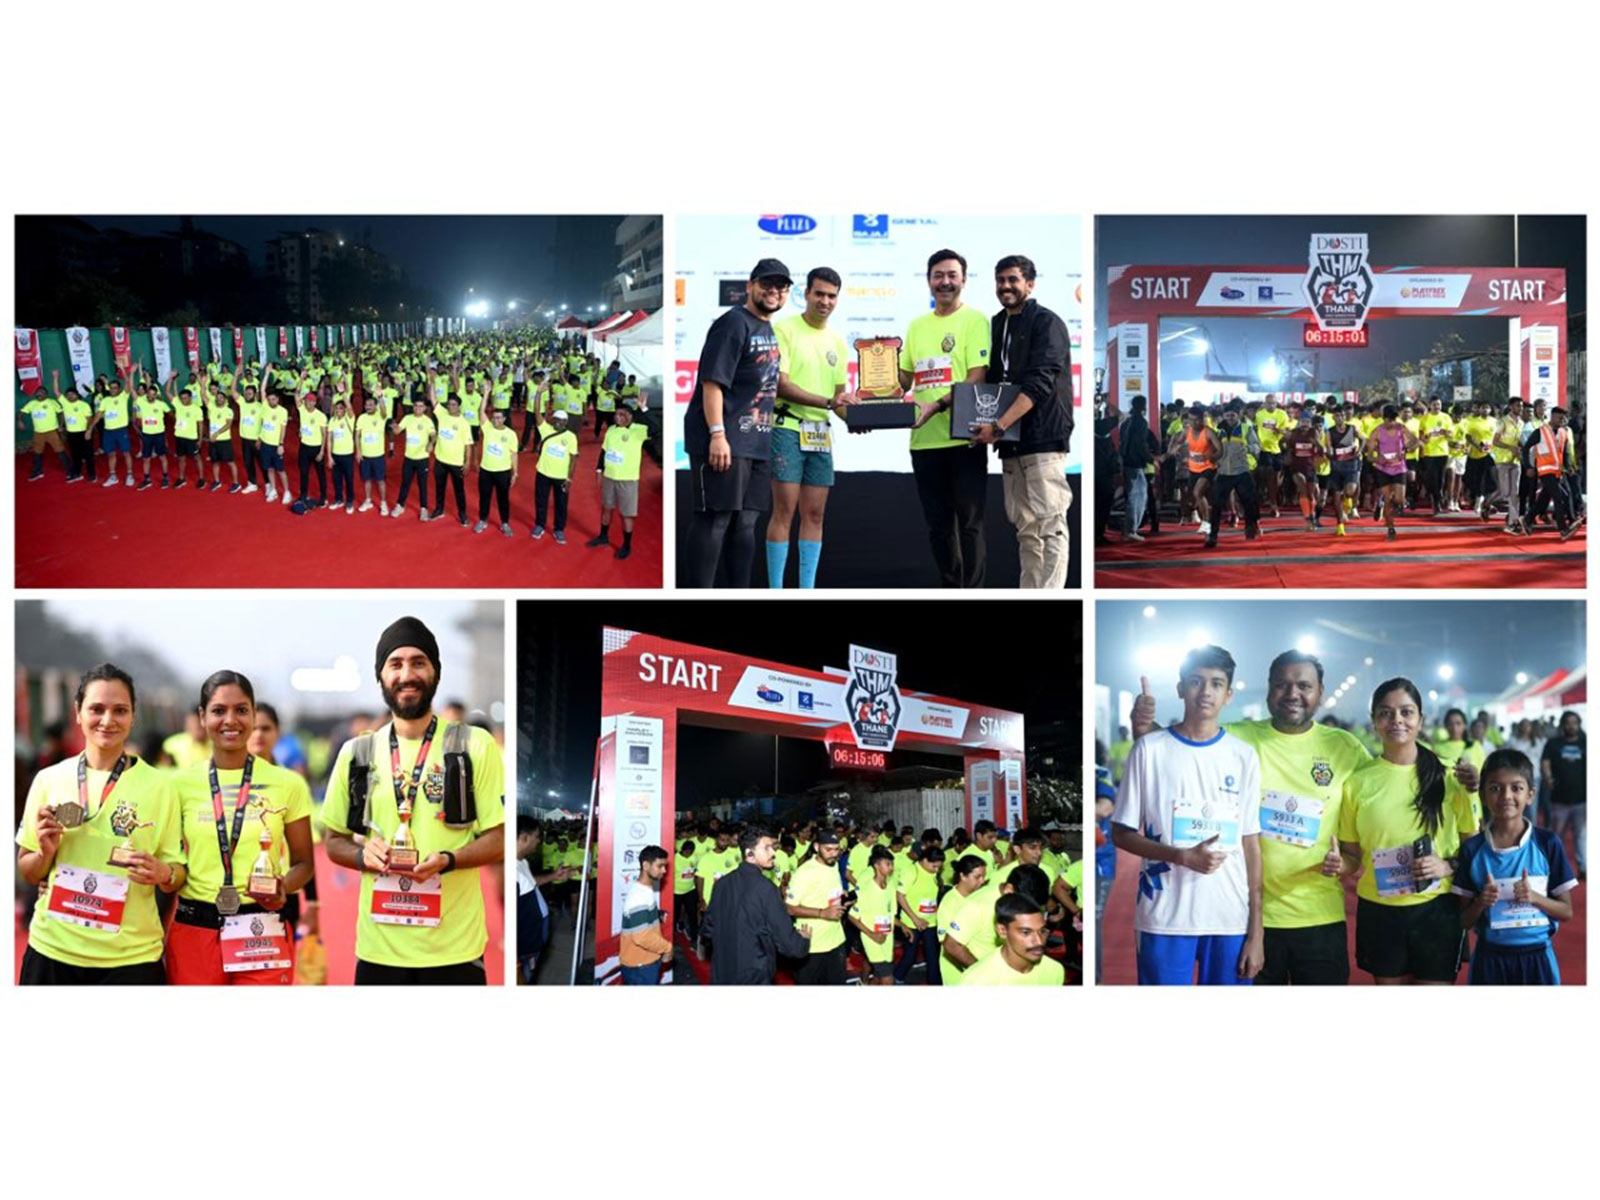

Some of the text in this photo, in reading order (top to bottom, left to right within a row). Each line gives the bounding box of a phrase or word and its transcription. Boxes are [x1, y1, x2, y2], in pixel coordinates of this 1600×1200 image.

[1317, 236, 1362, 250] DOSTI
[1320, 254, 1360, 277] THM
[1130, 277, 1191, 299] START
[1488, 279, 1546, 301] START
[1325, 304, 1356, 313] THANE
[1305, 330, 1367, 344] 06:15:01
[638, 652, 722, 692] START
[857, 669, 890, 697] THM
[862, 722, 888, 734] THANE
[834, 749, 885, 767] 06:15:06
